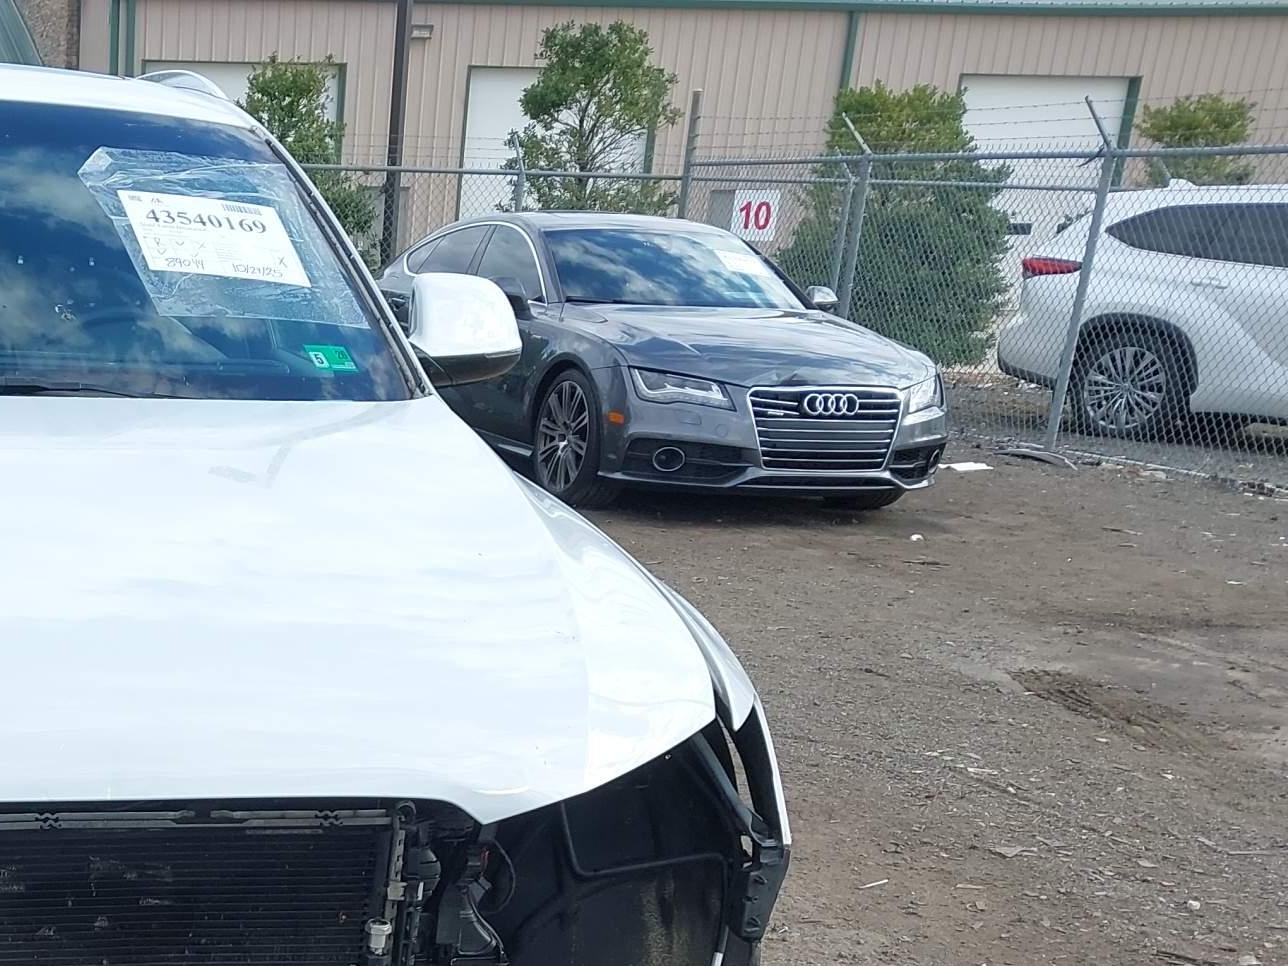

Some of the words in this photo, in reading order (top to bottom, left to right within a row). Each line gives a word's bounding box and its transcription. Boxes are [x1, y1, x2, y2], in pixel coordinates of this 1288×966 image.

[145, 208, 267, 235] 43540169
[740, 201, 771, 230] 10
[314, 353, 325, 365] 5
